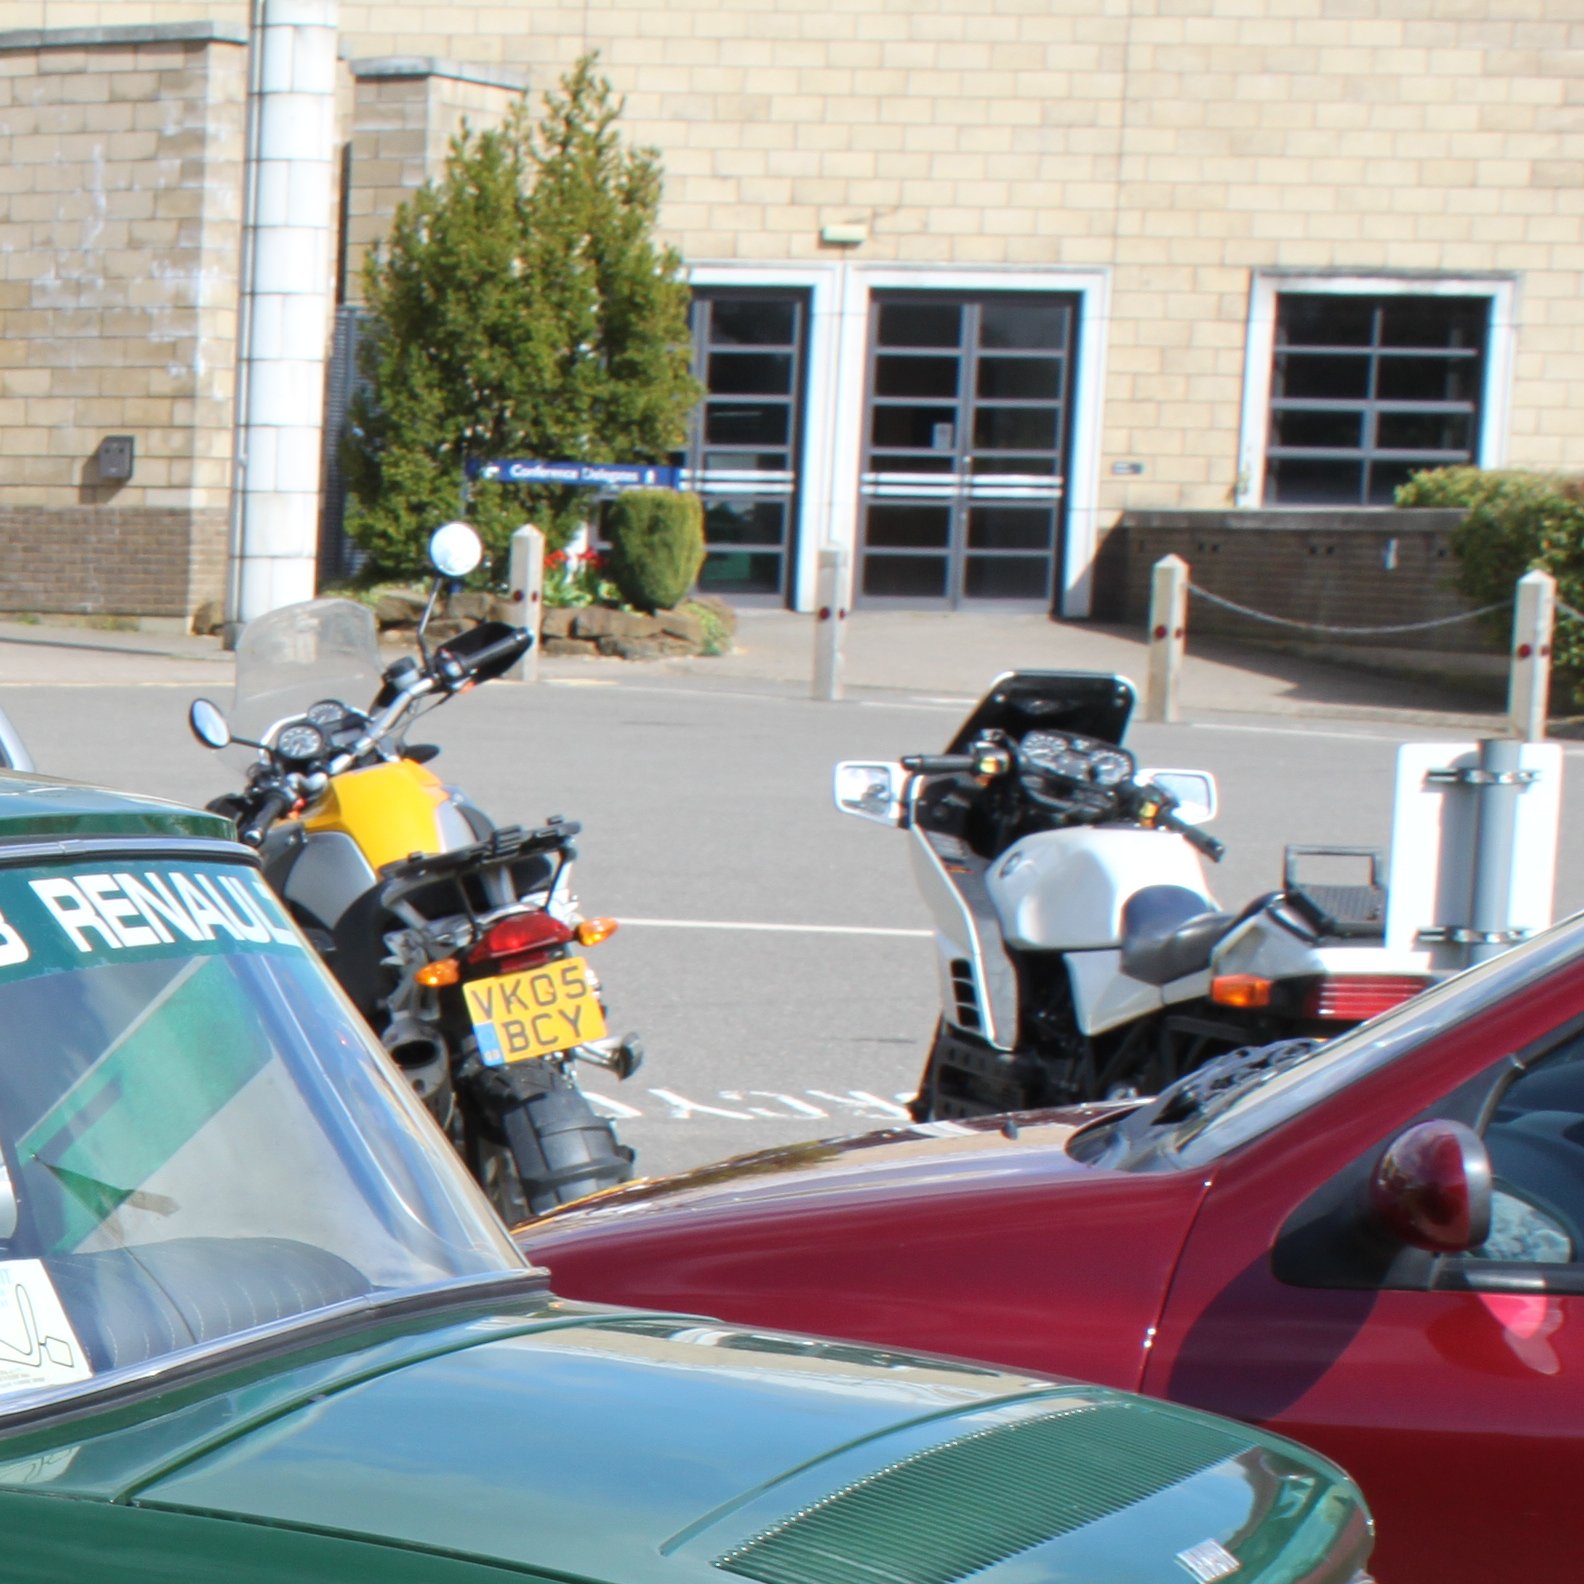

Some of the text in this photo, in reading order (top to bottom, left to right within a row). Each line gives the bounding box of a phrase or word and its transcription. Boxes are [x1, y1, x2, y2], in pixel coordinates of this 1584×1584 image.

[509, 462, 578, 481] Conference
[27, 871, 304, 953] RENAUL
[470, 964, 588, 1021] VK05
[501, 1004, 582, 1055] BCY
